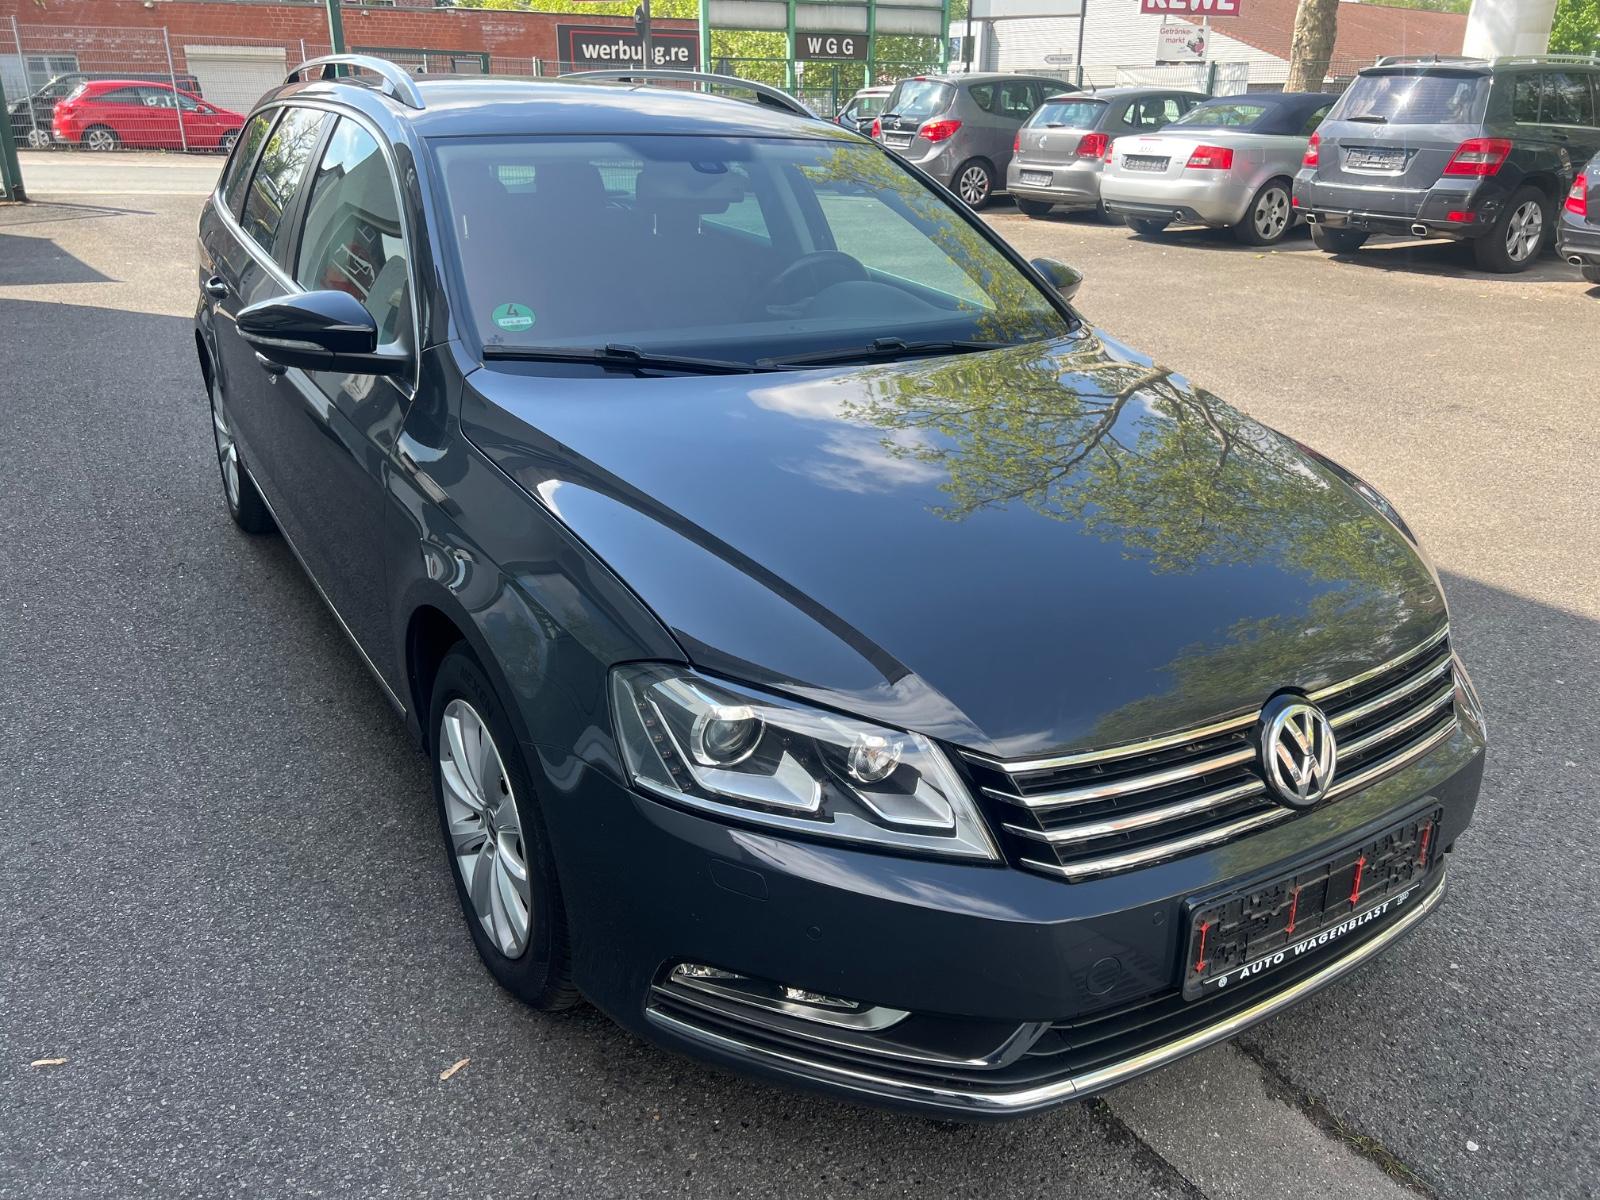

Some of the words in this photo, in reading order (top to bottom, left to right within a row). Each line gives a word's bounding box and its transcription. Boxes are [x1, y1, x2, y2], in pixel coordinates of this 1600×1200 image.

[582, 40, 689, 64] werbug.re
[506, 303, 520, 317] 4
[1240, 953, 1285, 980] AUTO
[1294, 903, 1389, 956] WAGENBLAST
